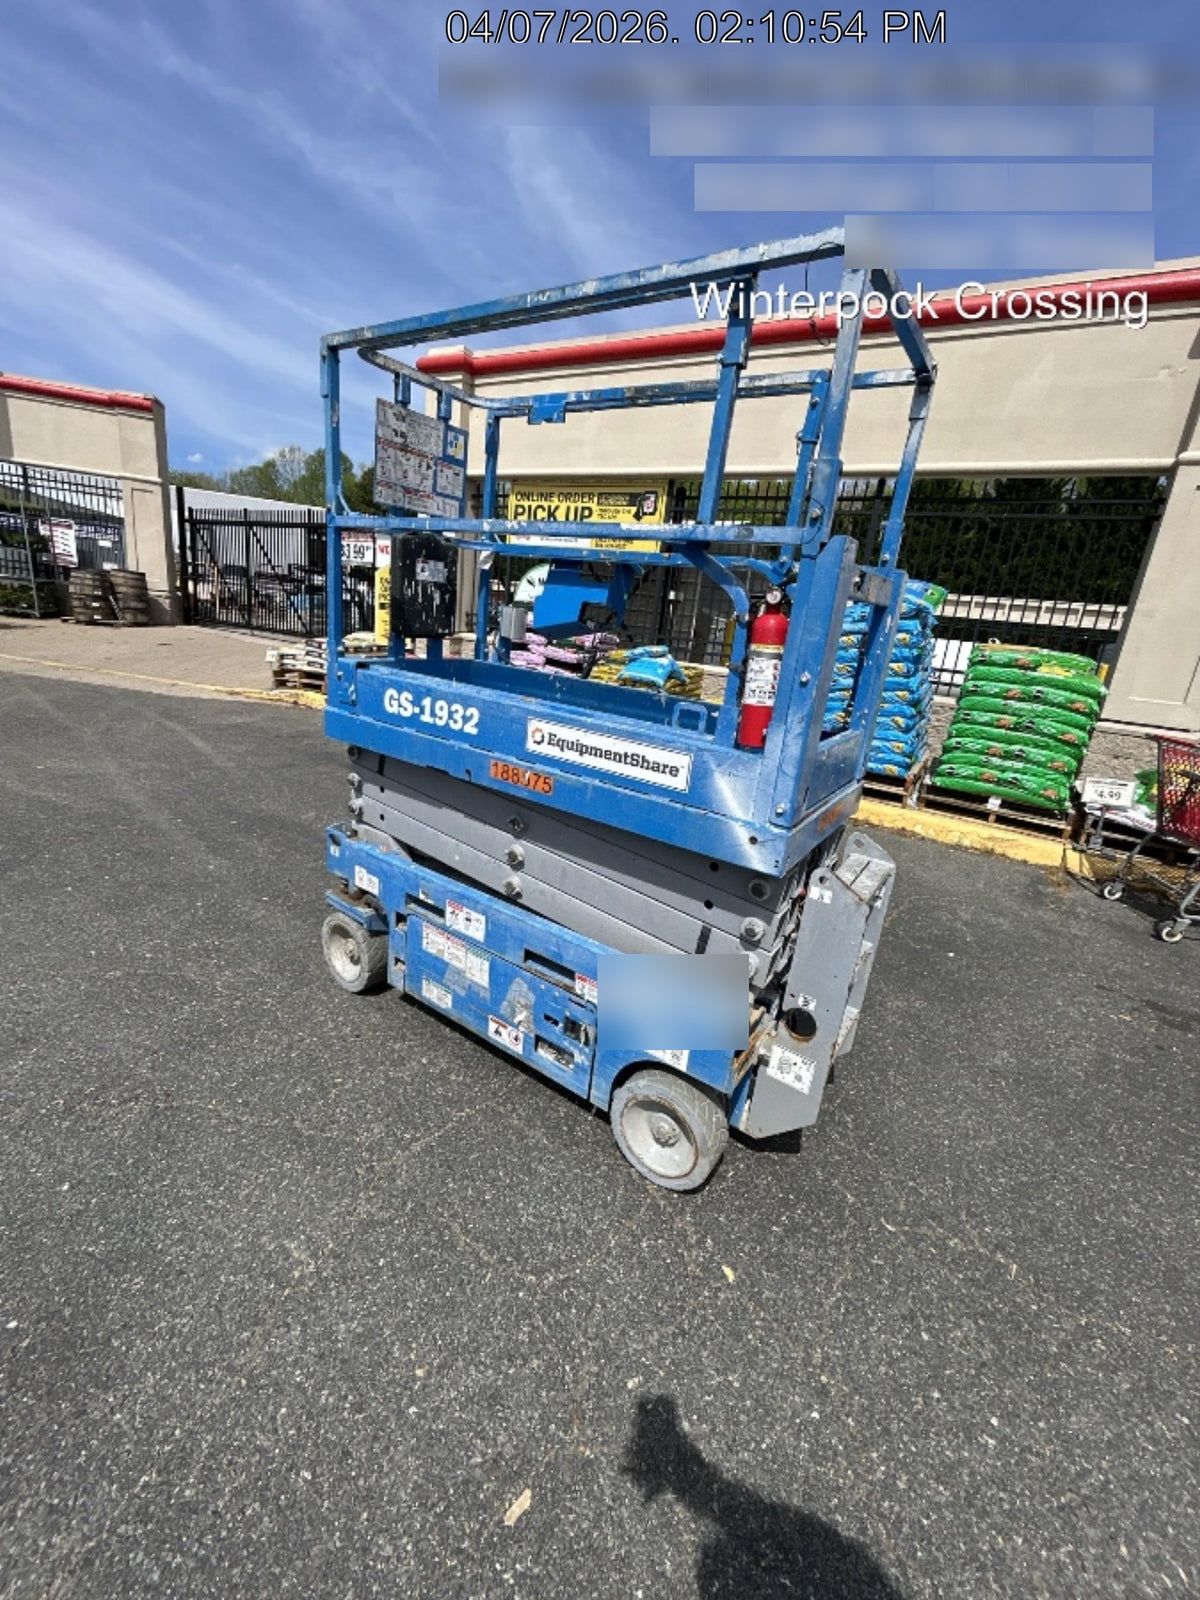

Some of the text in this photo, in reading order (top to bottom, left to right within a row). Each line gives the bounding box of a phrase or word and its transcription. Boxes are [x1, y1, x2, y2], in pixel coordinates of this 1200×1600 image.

[513, 504, 594, 523] PICK UP
[515, 491, 555, 504] ONLINE
[557, 491, 595, 505] ORDER
[383, 687, 480, 736] GS-1932
[546, 732, 680, 778] EquipmentShare
